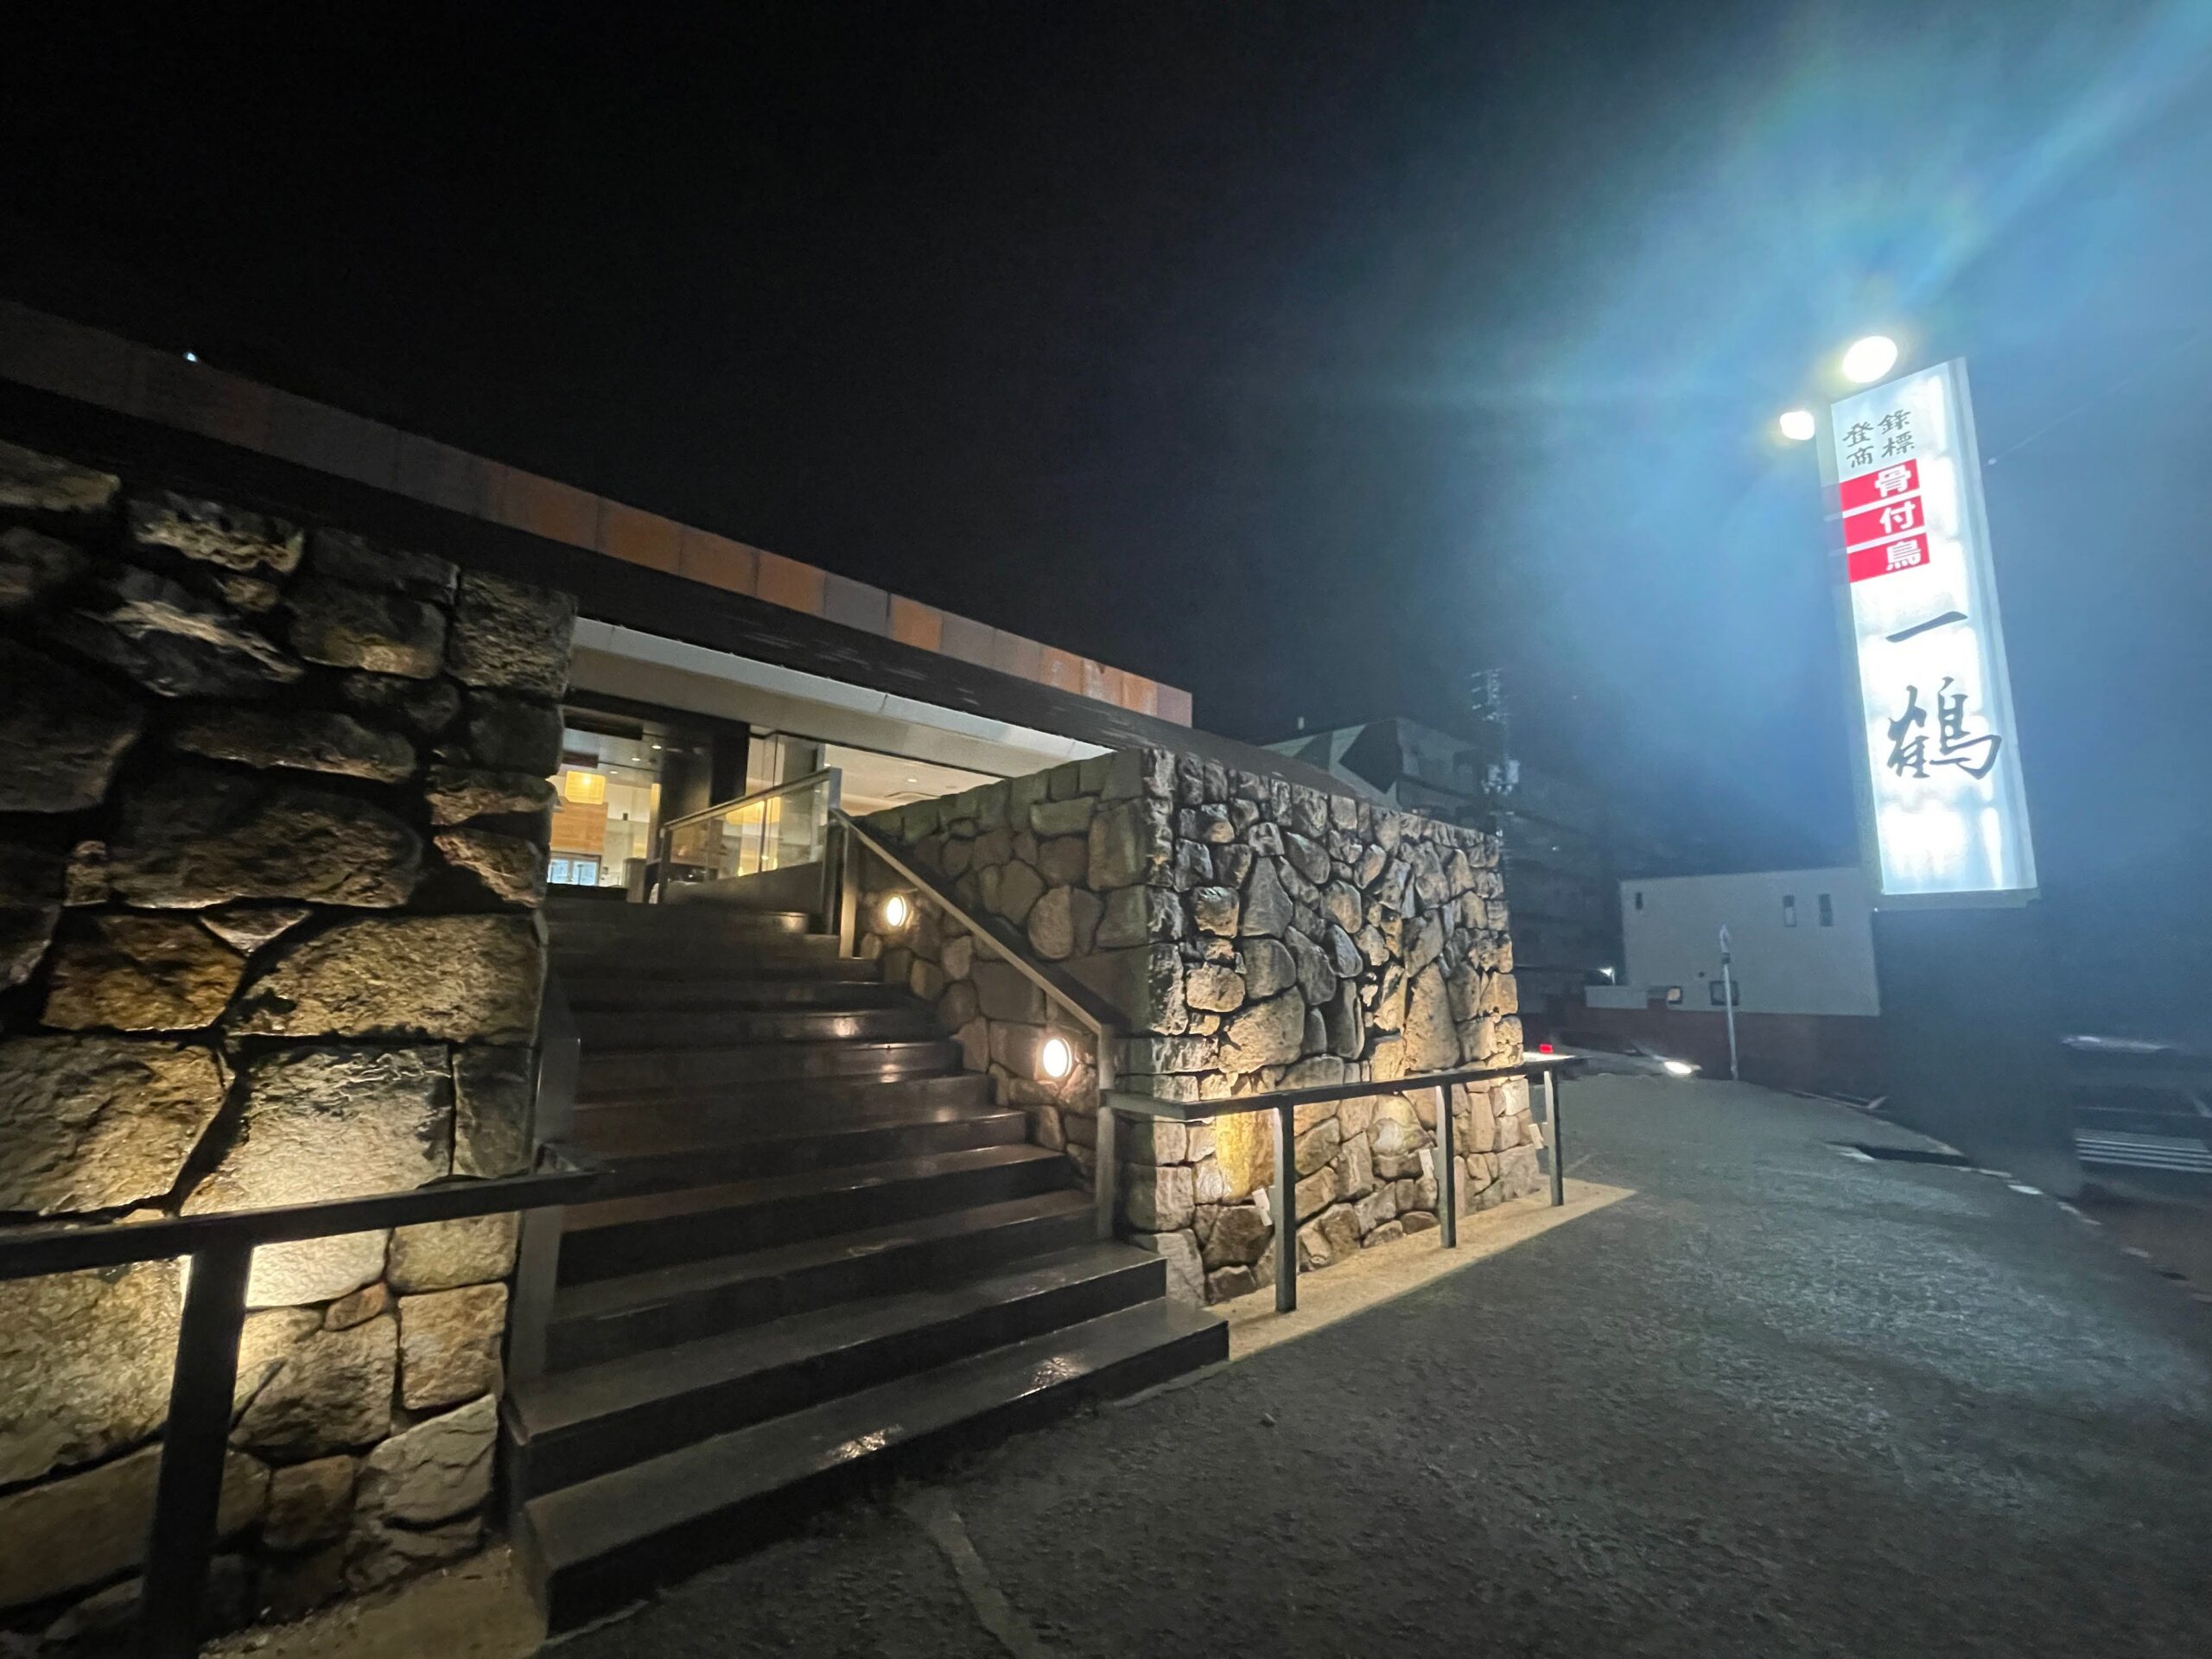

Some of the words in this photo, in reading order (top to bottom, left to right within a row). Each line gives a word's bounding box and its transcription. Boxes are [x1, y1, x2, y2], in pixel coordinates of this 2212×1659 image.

[1847, 431, 1915, 468] 商標
[1874, 464, 1922, 571] 骨付鳥
[1885, 611, 2002, 780] 一鶴
